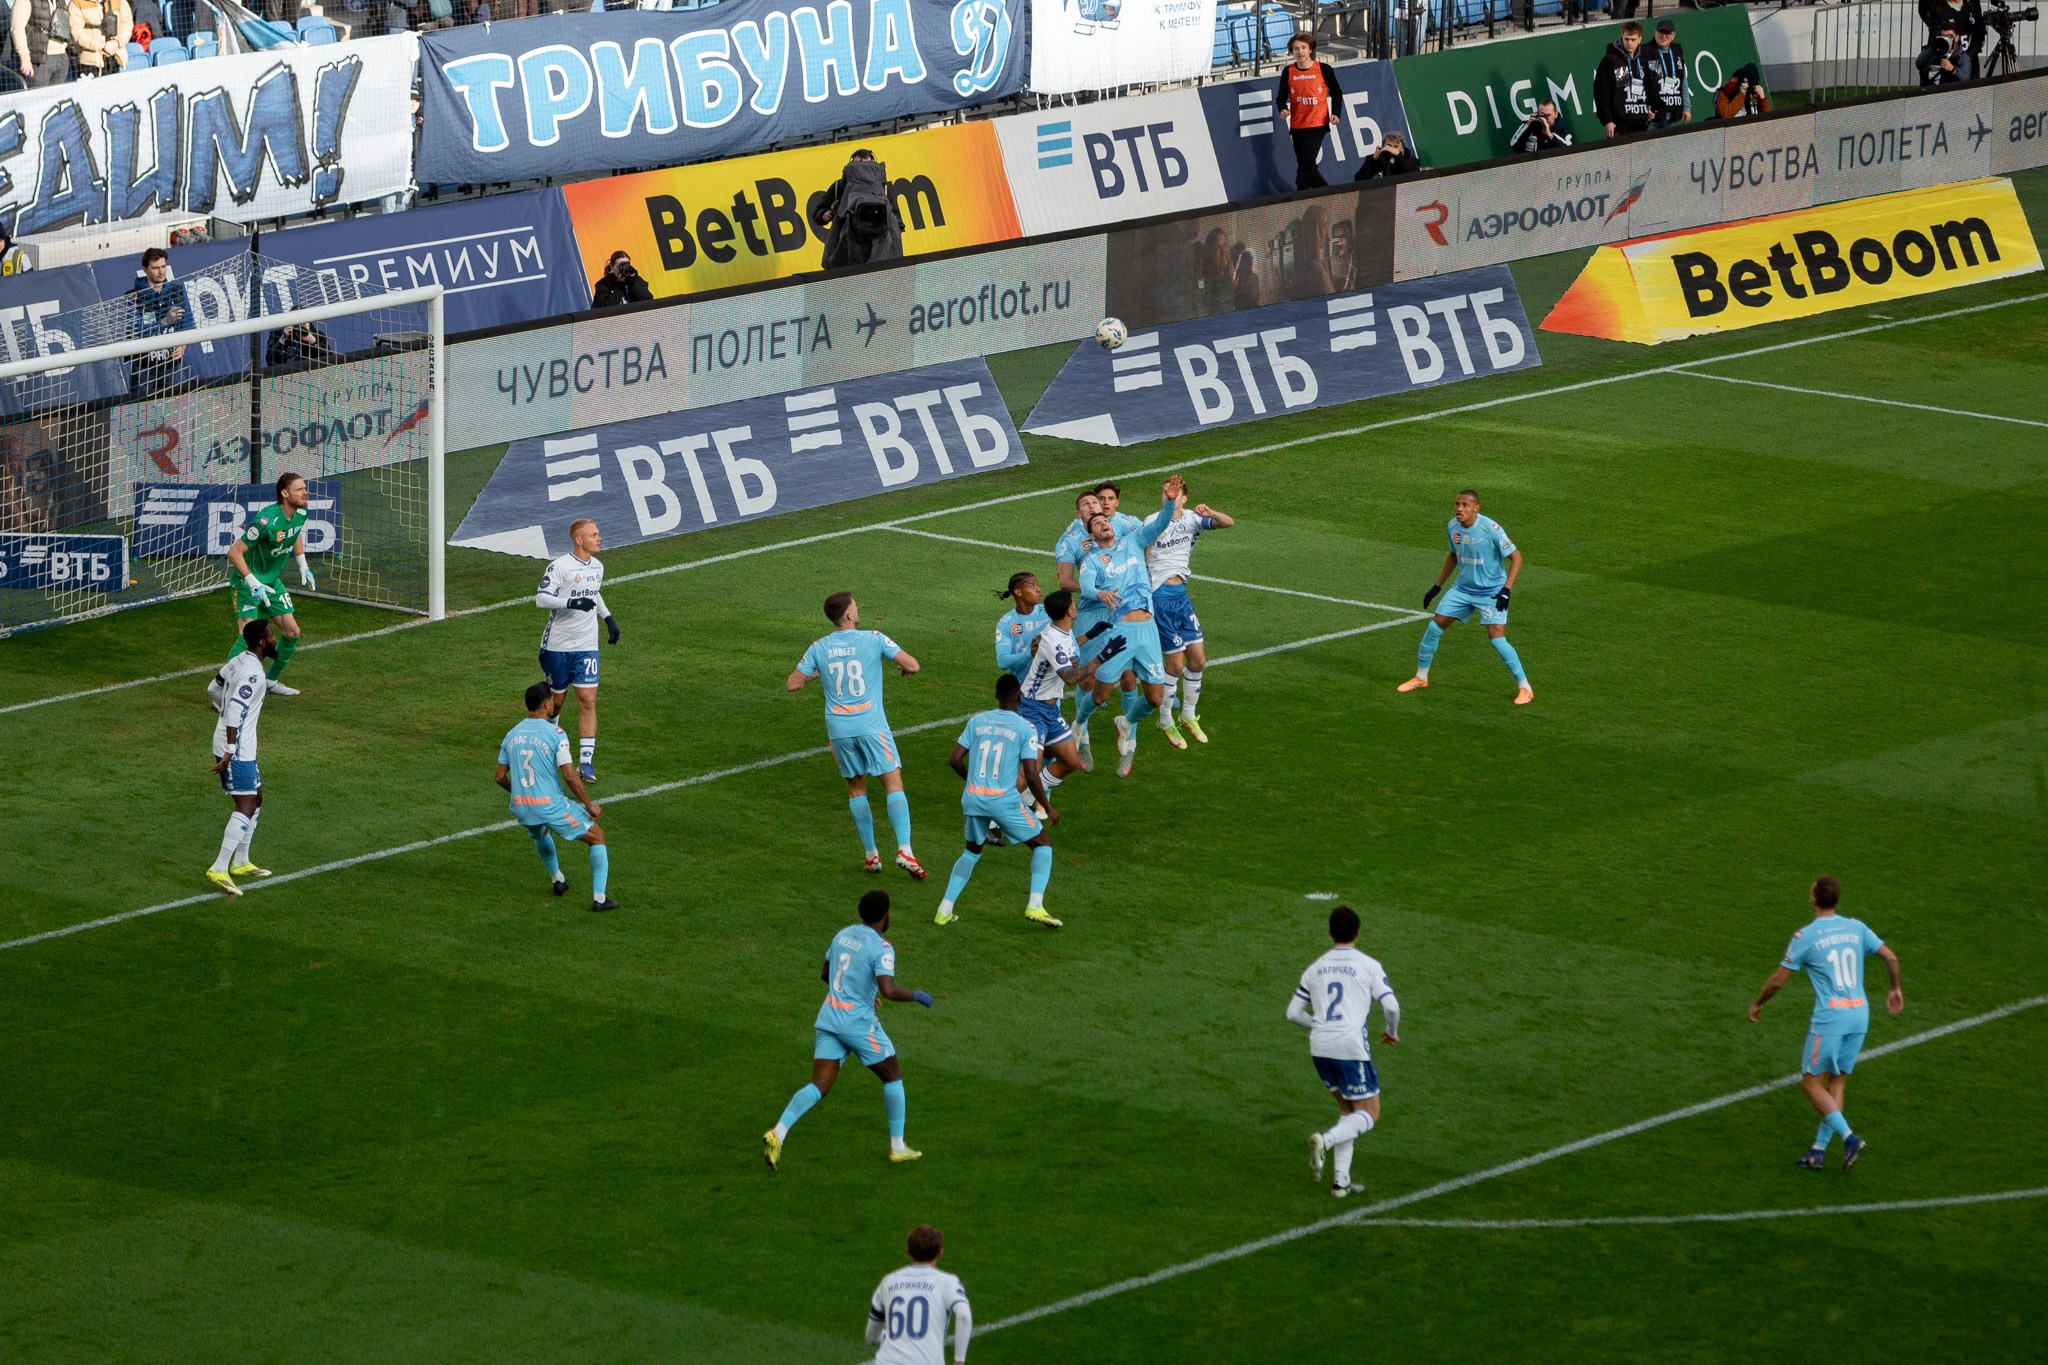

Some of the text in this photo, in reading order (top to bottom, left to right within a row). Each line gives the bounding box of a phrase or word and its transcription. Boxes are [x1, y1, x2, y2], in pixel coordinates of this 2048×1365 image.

[443, 0, 927, 152] ТРИБУНА
[1302, 96, 1318, 106] ВТБ
[1446, 68, 1597, 135] DIGM
[1083, 121, 1189, 199] ВТБ
[1691, 111, 2048, 194] ЧУВСТВА ПОЛЕТА aer
[1557, 170, 1611, 190] ГРУППА
[645, 174, 946, 271] BetBom
[1466, 194, 1610, 242] АЭРОФЛОТ
[317, 236, 544, 305] ПРЕМИУМ
[1671, 217, 2001, 318] BetBoom
[497, 279, 1071, 405] ЧУВСТВА ПОЛЕТА aeroflot.ru
[1387, 287, 1525, 385] ВТБ
[1173, 326, 1319, 425] ВТБ
[852, 381, 1010, 487] ВТБ
[615, 425, 778, 537] ВТБ
[51, 552, 111, 581] ВТБ
[584, 658, 598, 675] 70
[828, 647, 856, 659] ДИВЕЕВ
[828, 659, 866, 699] 78
[520, 749, 535, 788] 3
[979, 740, 1004, 780] 11
[1317, 966, 1357, 978] МАРИЧАЛЬ
[1826, 947, 1857, 992] 10
[1326, 981, 1344, 1022] 2
[888, 1281, 936, 1295] МАРИНКИН
[888, 1296, 930, 1341] 60
